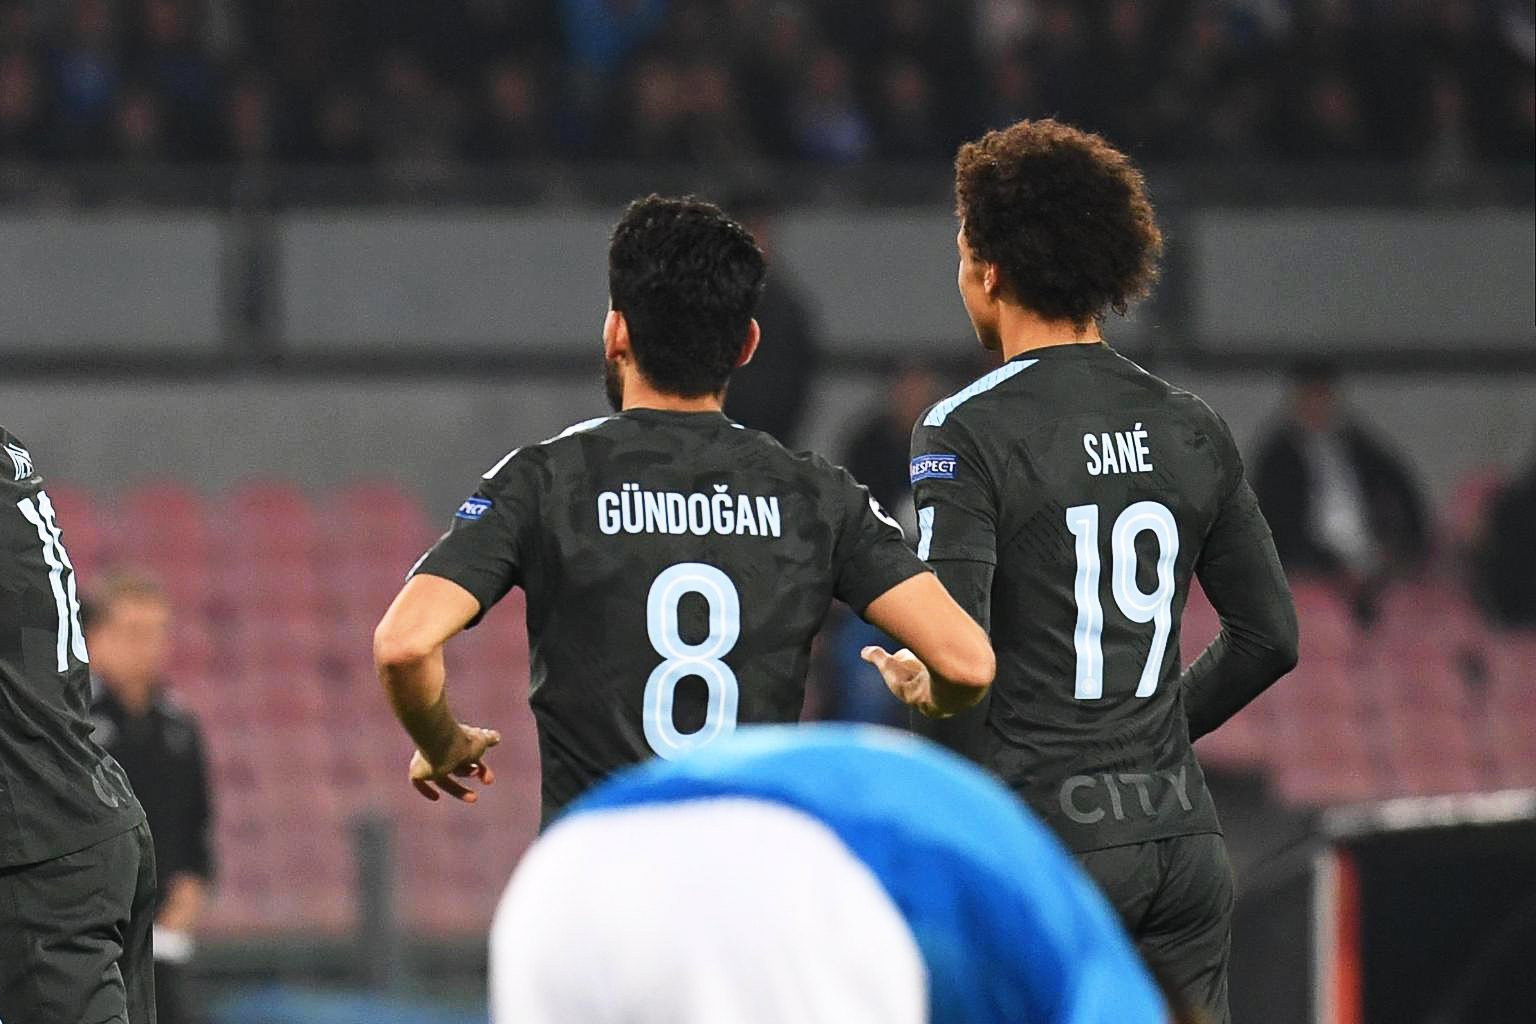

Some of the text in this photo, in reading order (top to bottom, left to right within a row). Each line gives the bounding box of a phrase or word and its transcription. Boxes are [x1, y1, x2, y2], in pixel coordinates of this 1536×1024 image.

[1083, 423, 1154, 476] SANÉ
[597, 483, 782, 537] GÜNDOĞAN
[1065, 500, 1180, 699] 19
[642, 562, 741, 764] 8
[1059, 765, 1194, 825] CITY
